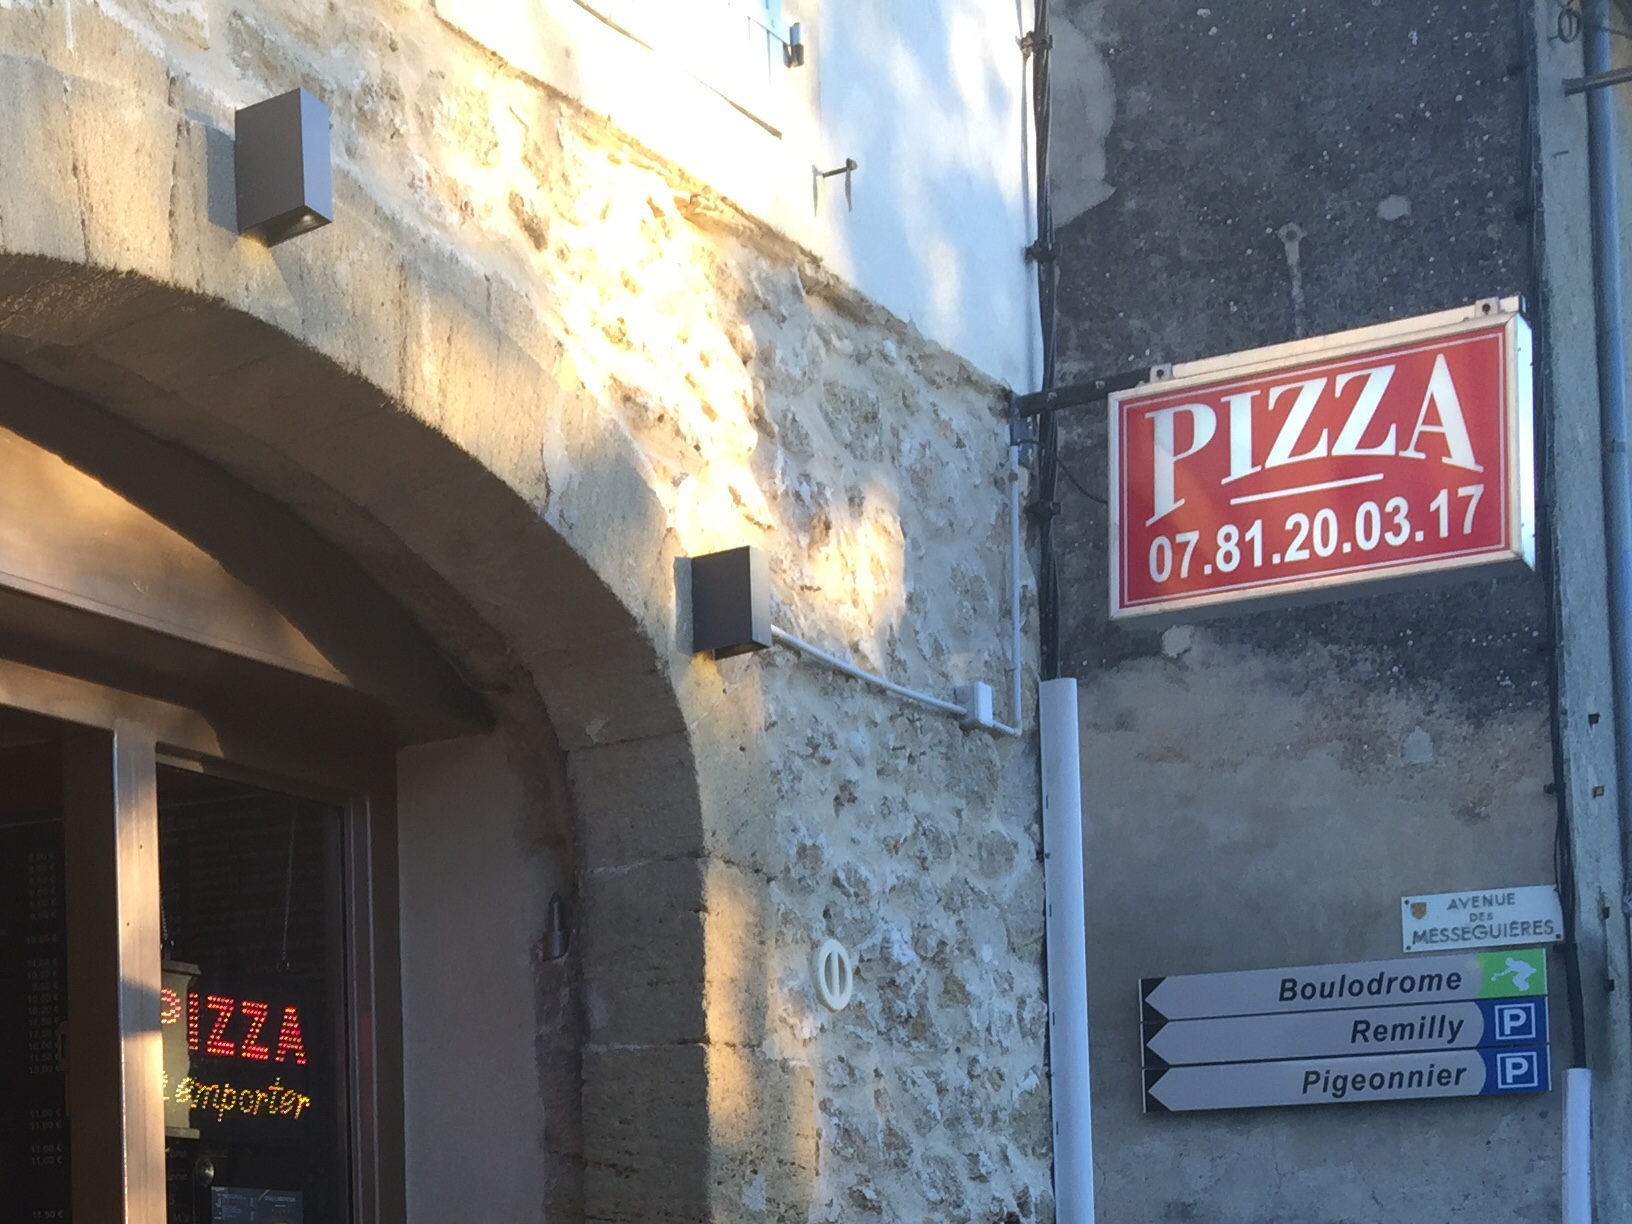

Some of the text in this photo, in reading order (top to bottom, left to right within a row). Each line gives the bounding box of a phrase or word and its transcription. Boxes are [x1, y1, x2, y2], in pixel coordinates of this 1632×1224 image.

[1144, 353, 1484, 527] PIZZA
[1149, 484, 1484, 583] 07.81.20.03.17
[1446, 892, 1516, 911] AVENUE
[1469, 912, 1494, 923] DES
[1279, 971, 1462, 1001] Boulodrome
[1351, 1009, 1526, 1044] Remilly P
[1302, 1057, 1528, 1097] Pigeonnier P
[175, 1076, 311, 1122] emporter
